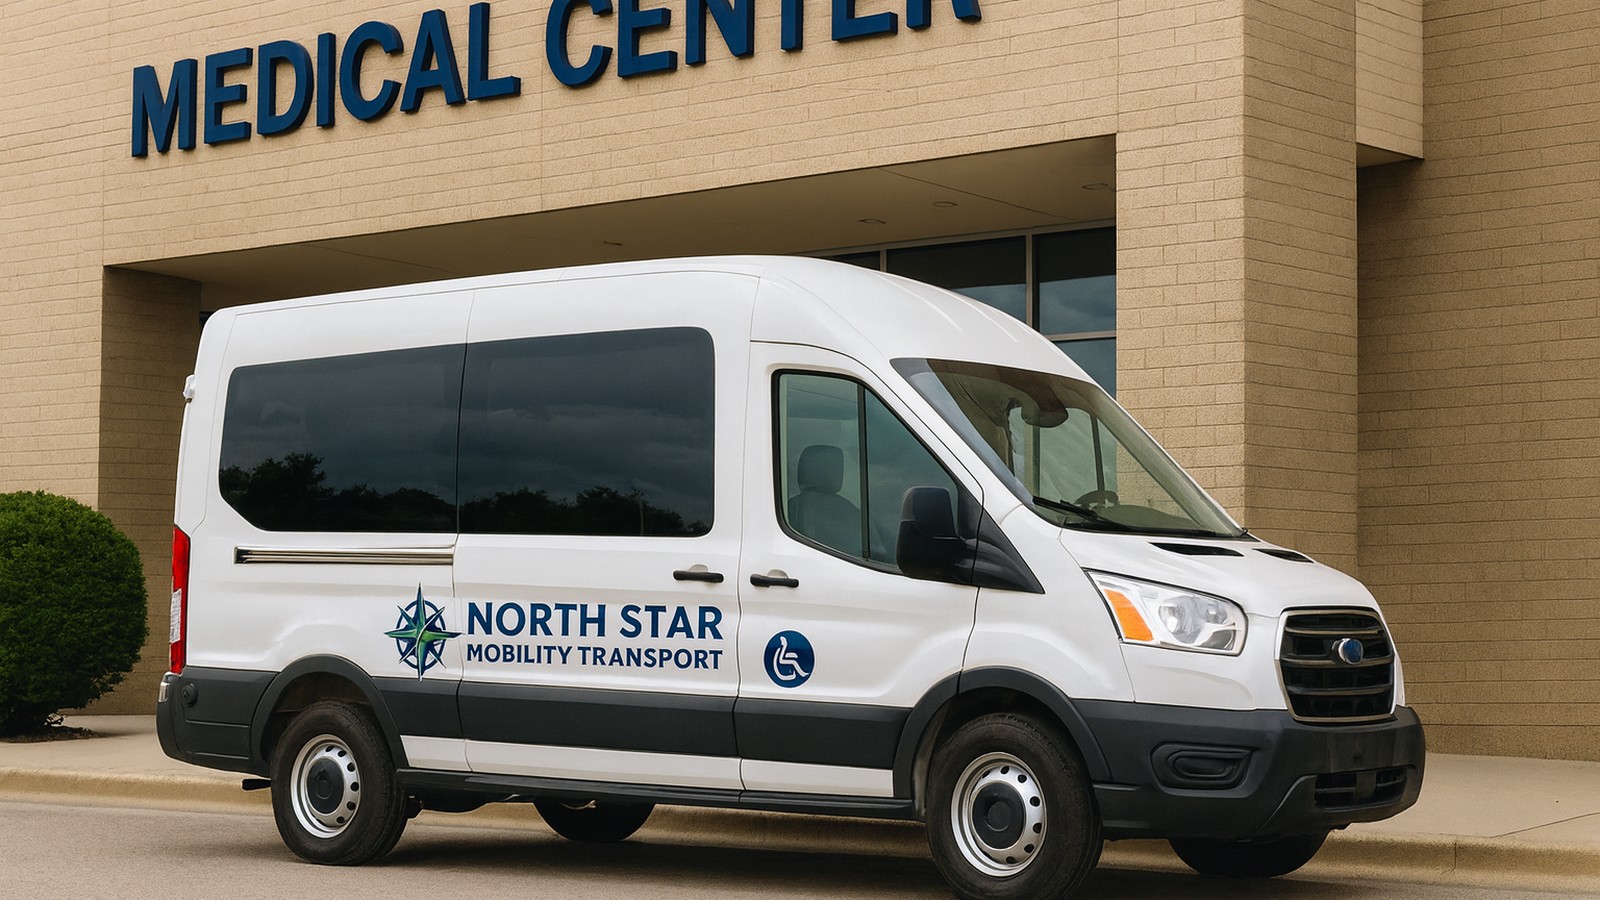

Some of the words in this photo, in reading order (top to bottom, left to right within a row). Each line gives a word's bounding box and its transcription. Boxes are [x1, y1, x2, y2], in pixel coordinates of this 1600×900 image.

[131, 2, 521, 157] MEDICAL
[545, 0, 981, 87] CEN
[466, 601, 607, 638] NORTH
[619, 604, 724, 641] STAR
[466, 643, 572, 665] MOBILITY
[577, 645, 724, 671] TRANSPORT
